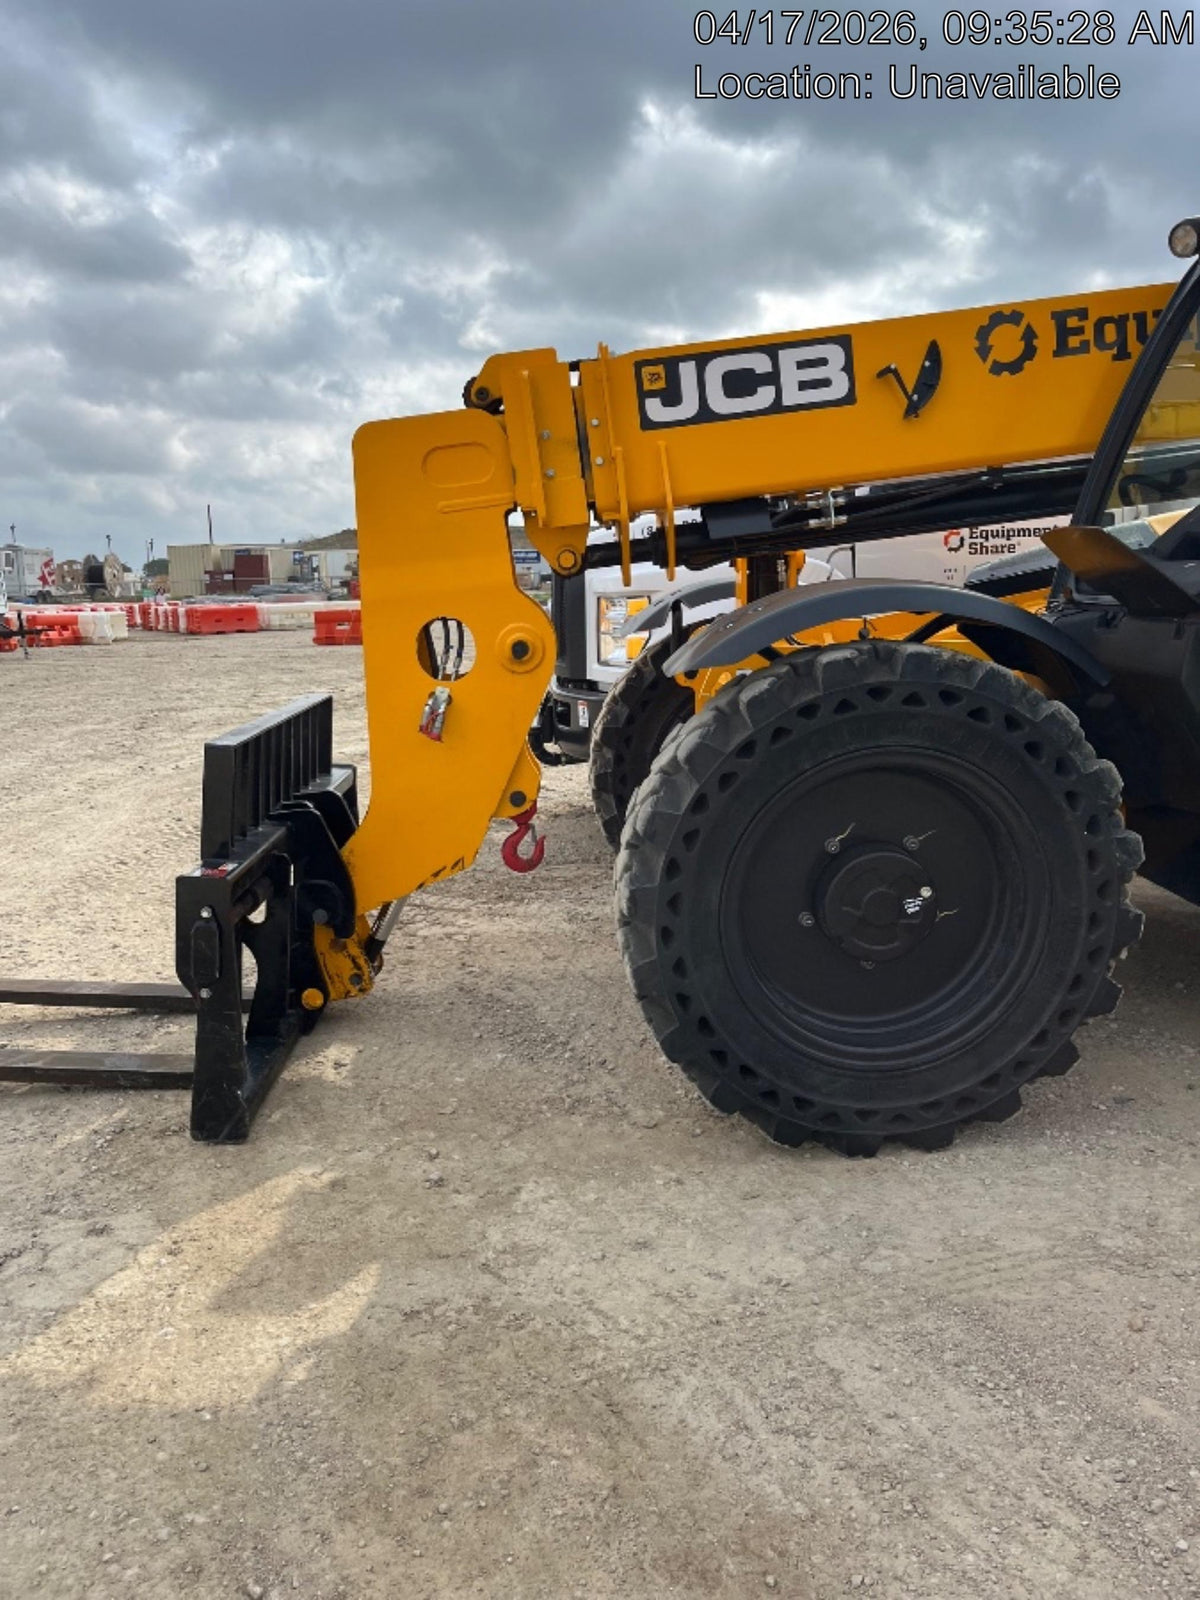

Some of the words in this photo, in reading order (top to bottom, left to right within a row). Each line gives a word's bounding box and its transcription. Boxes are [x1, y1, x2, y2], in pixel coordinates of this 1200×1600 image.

[645, 343, 850, 423] JCB
[968, 525, 1057, 541] Equipme
[968, 541, 1017, 555] Share
